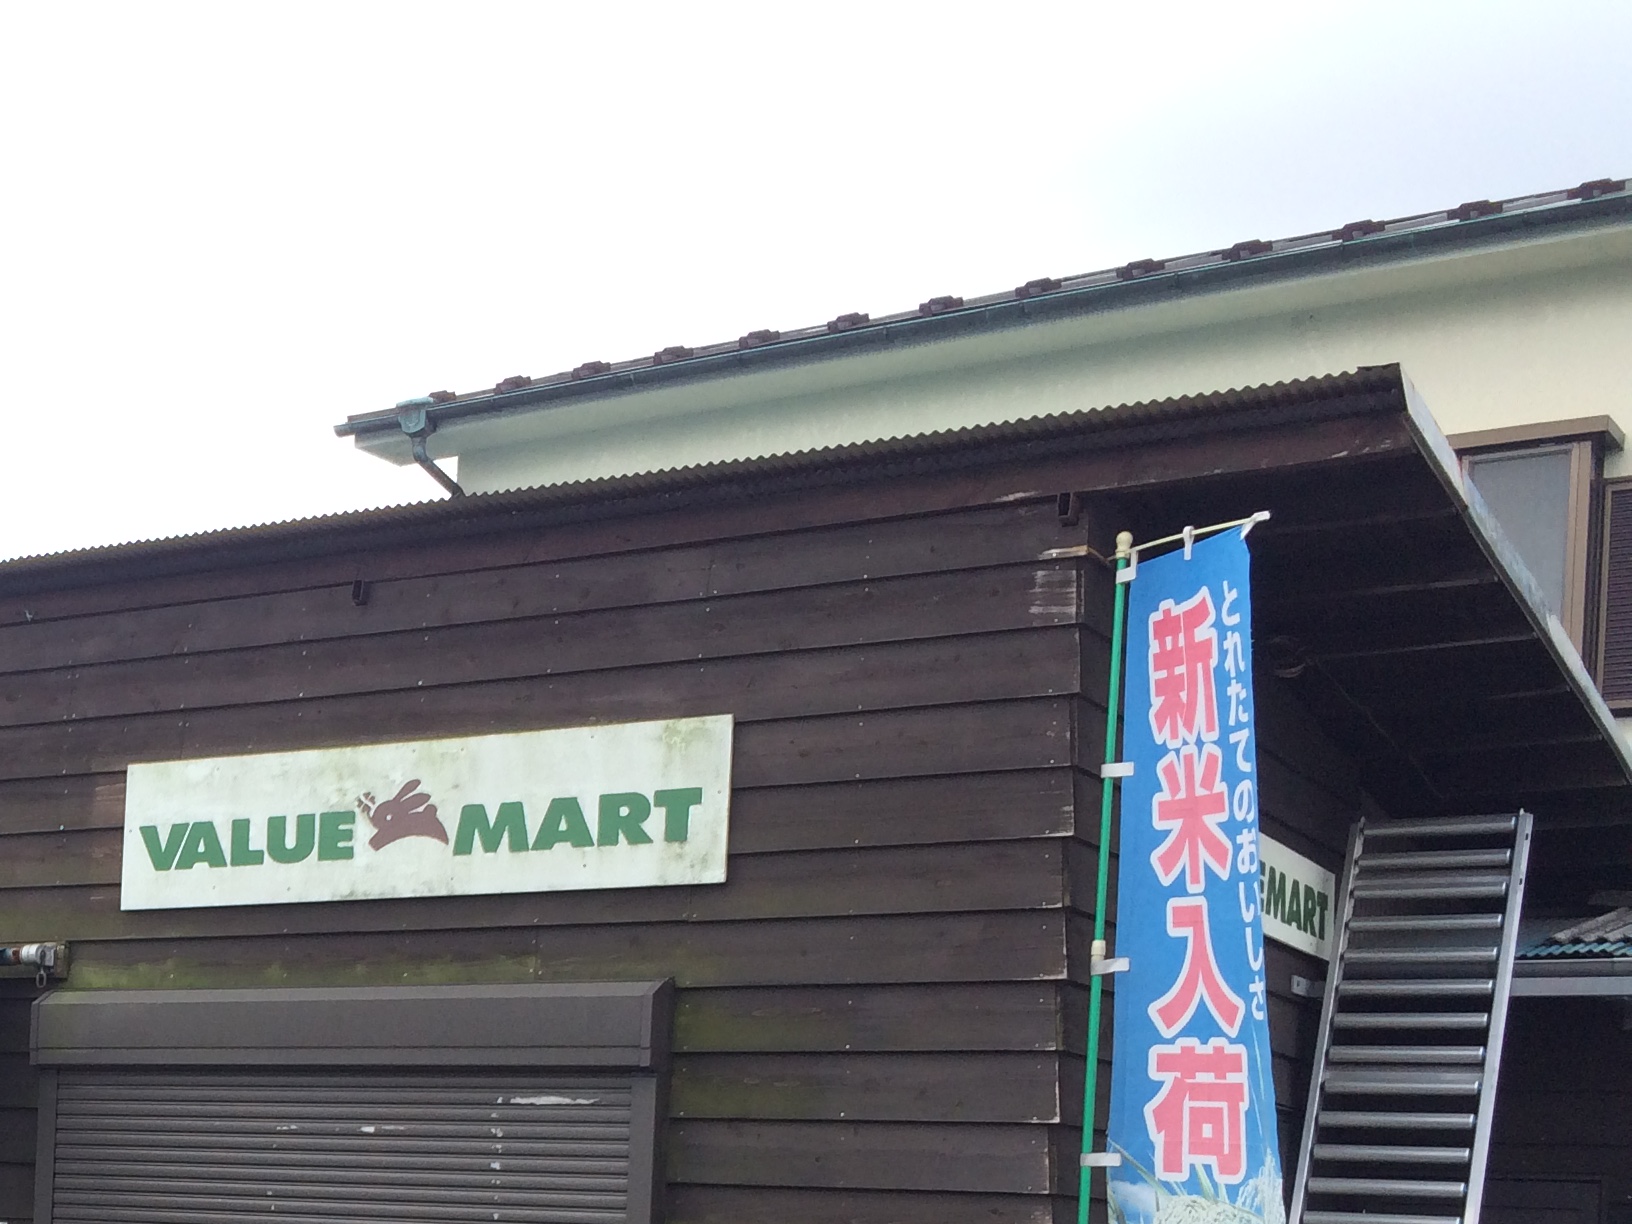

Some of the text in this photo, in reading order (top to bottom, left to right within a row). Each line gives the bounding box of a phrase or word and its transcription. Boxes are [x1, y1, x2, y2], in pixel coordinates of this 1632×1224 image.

[139, 787, 703, 871] VALUE MART
[1144, 586, 1249, 1184] 新米入荷
[1221, 580, 1265, 1021] とれたてのおいしさ
